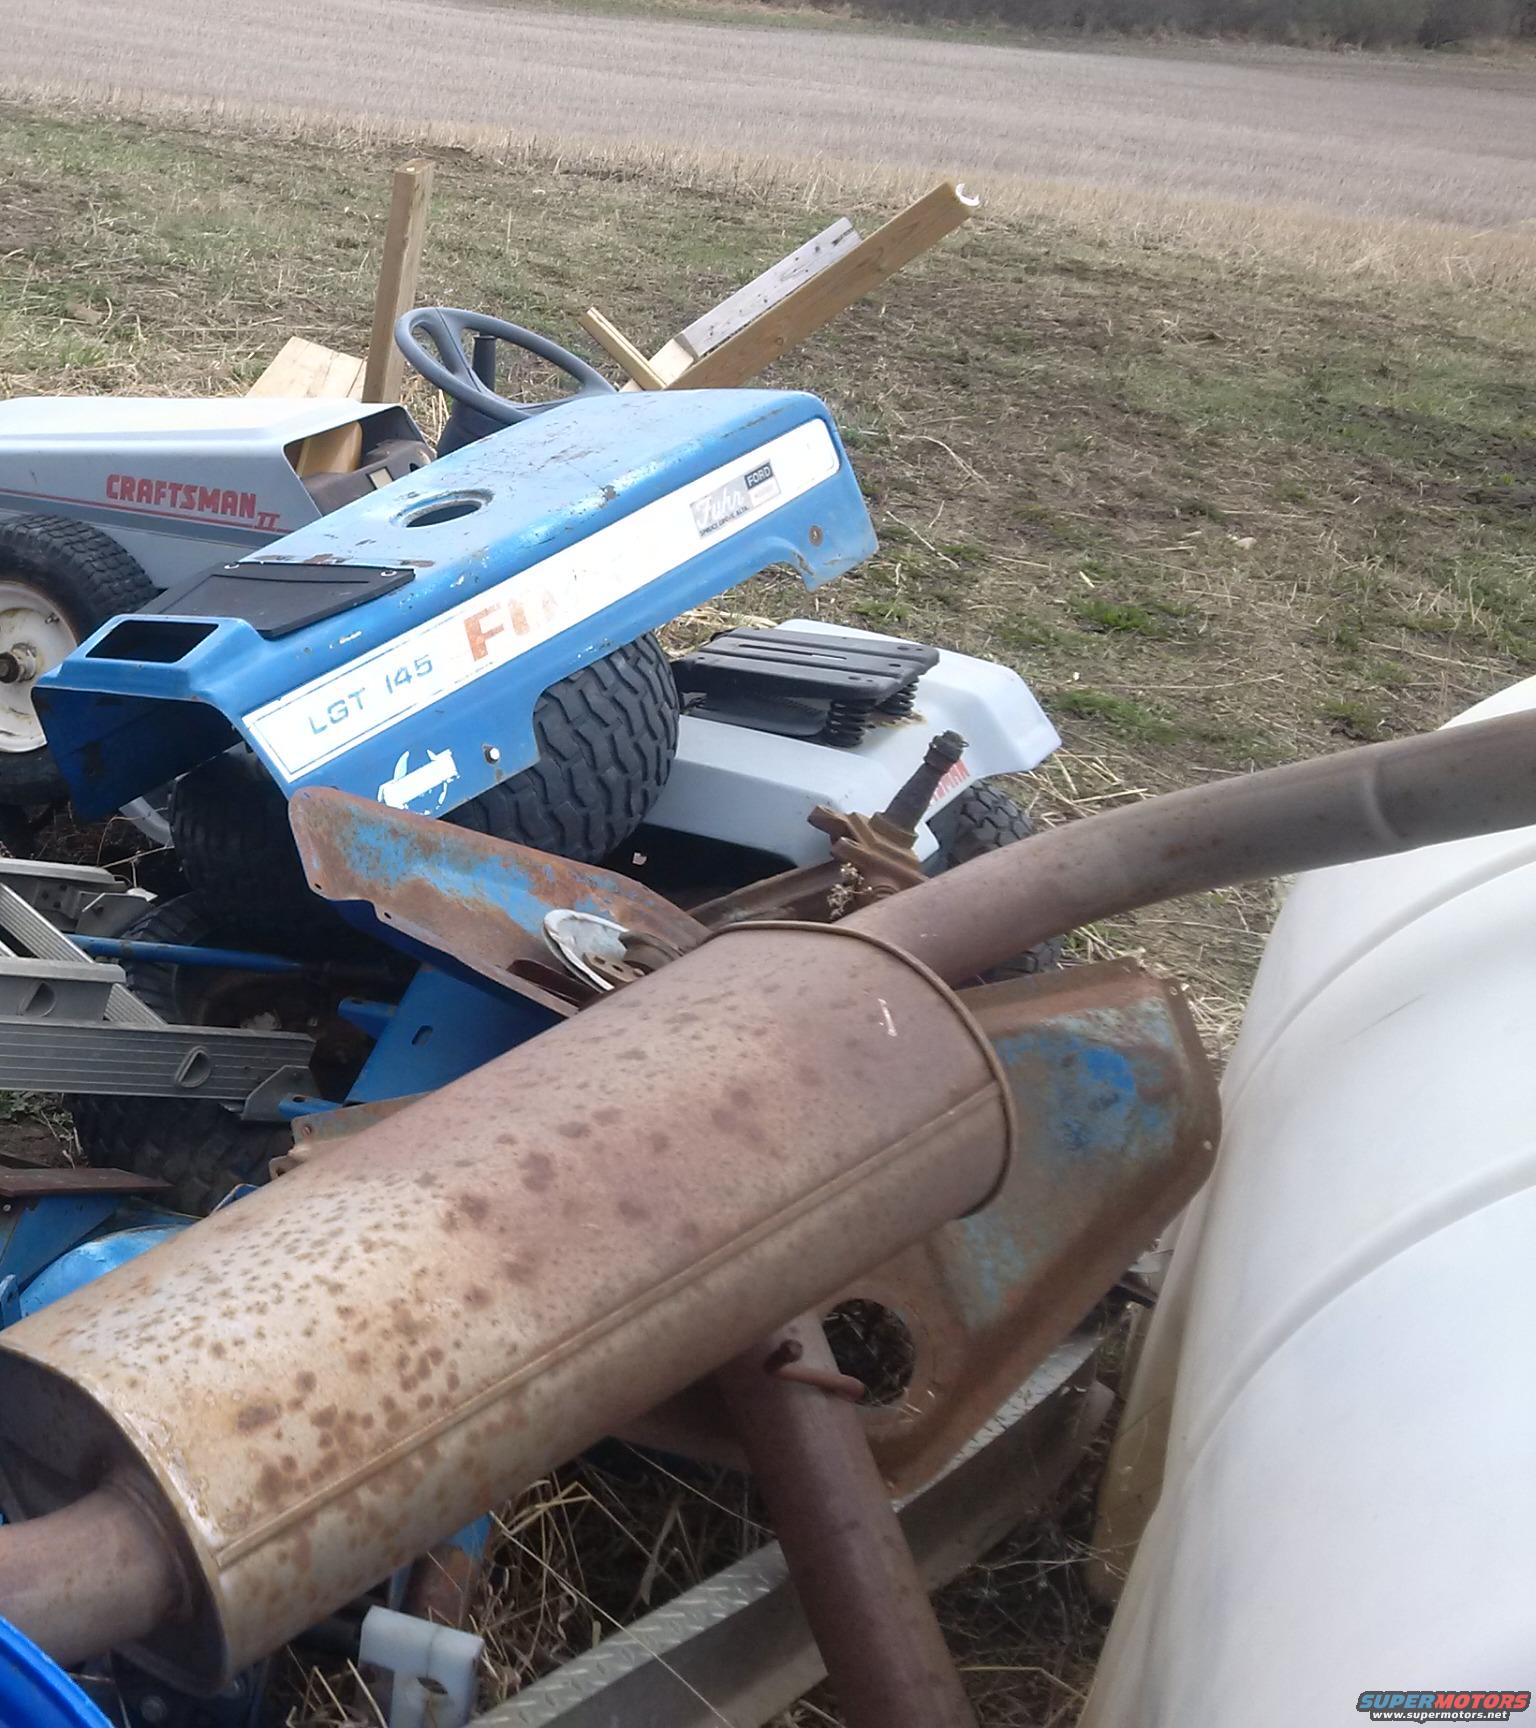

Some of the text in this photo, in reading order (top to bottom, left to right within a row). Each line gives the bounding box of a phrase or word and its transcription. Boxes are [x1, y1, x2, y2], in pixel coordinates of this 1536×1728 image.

[105, 473, 282, 531] CRAFTSMAN II
[747, 466, 771, 487] FORD
[308, 654, 434, 736] LGT 145
